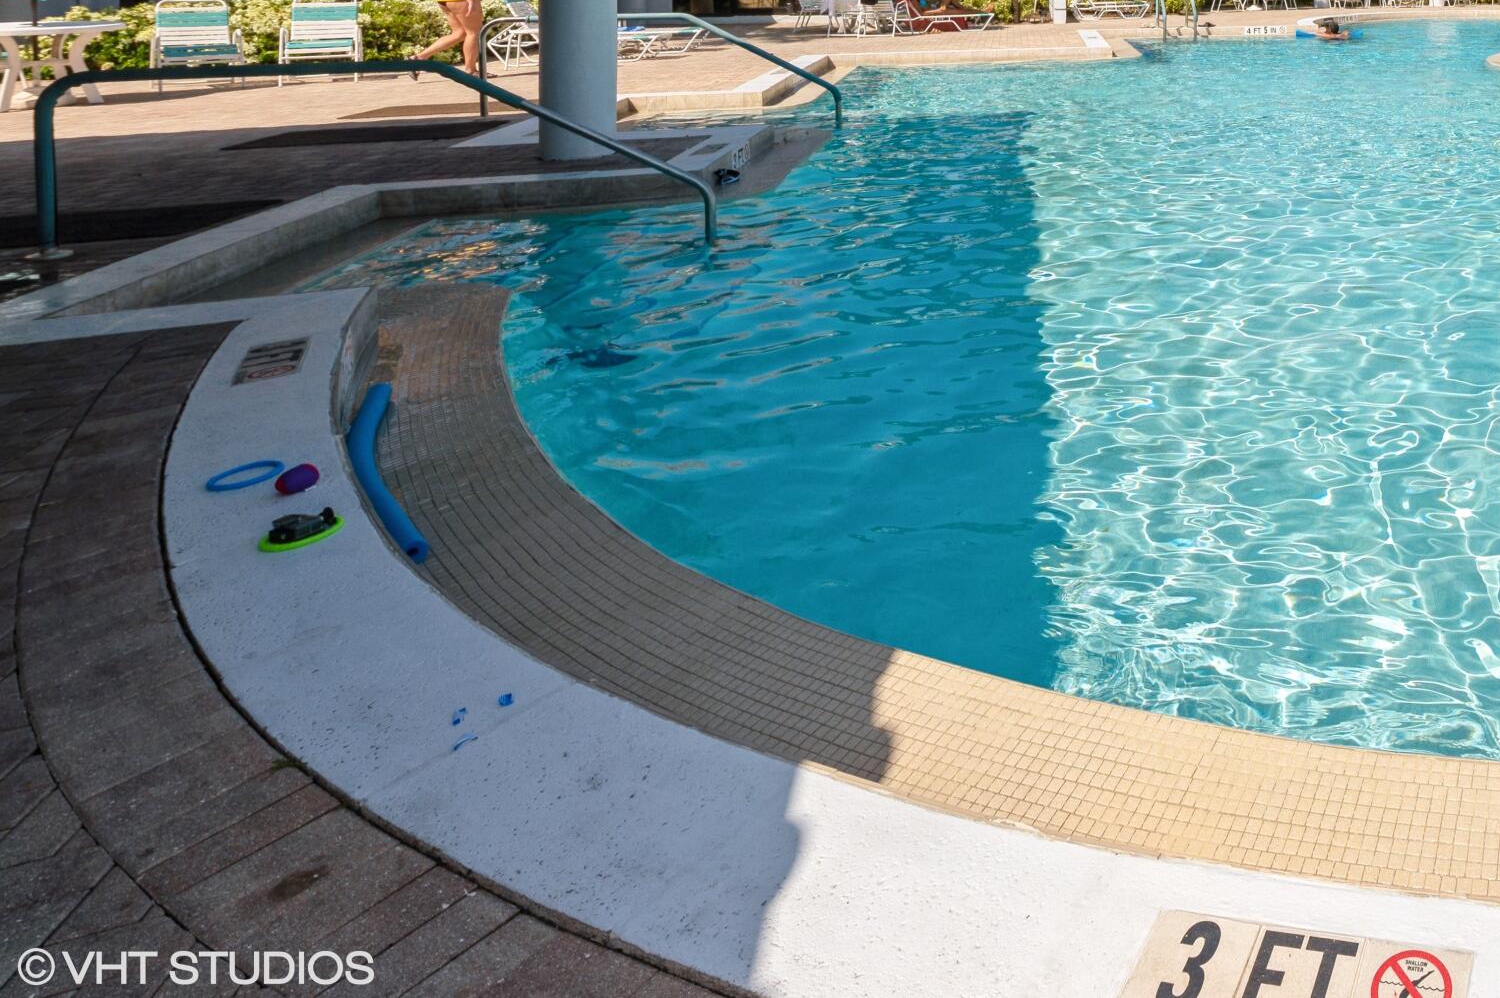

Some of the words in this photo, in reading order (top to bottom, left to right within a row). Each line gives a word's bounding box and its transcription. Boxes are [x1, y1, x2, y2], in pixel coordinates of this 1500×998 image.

[1264, 26, 1268, 34] 5
[1155, 920, 1222, 998] 3
[1242, 930, 1360, 998] FT
[1405, 960, 1429, 968] SHALLOW
